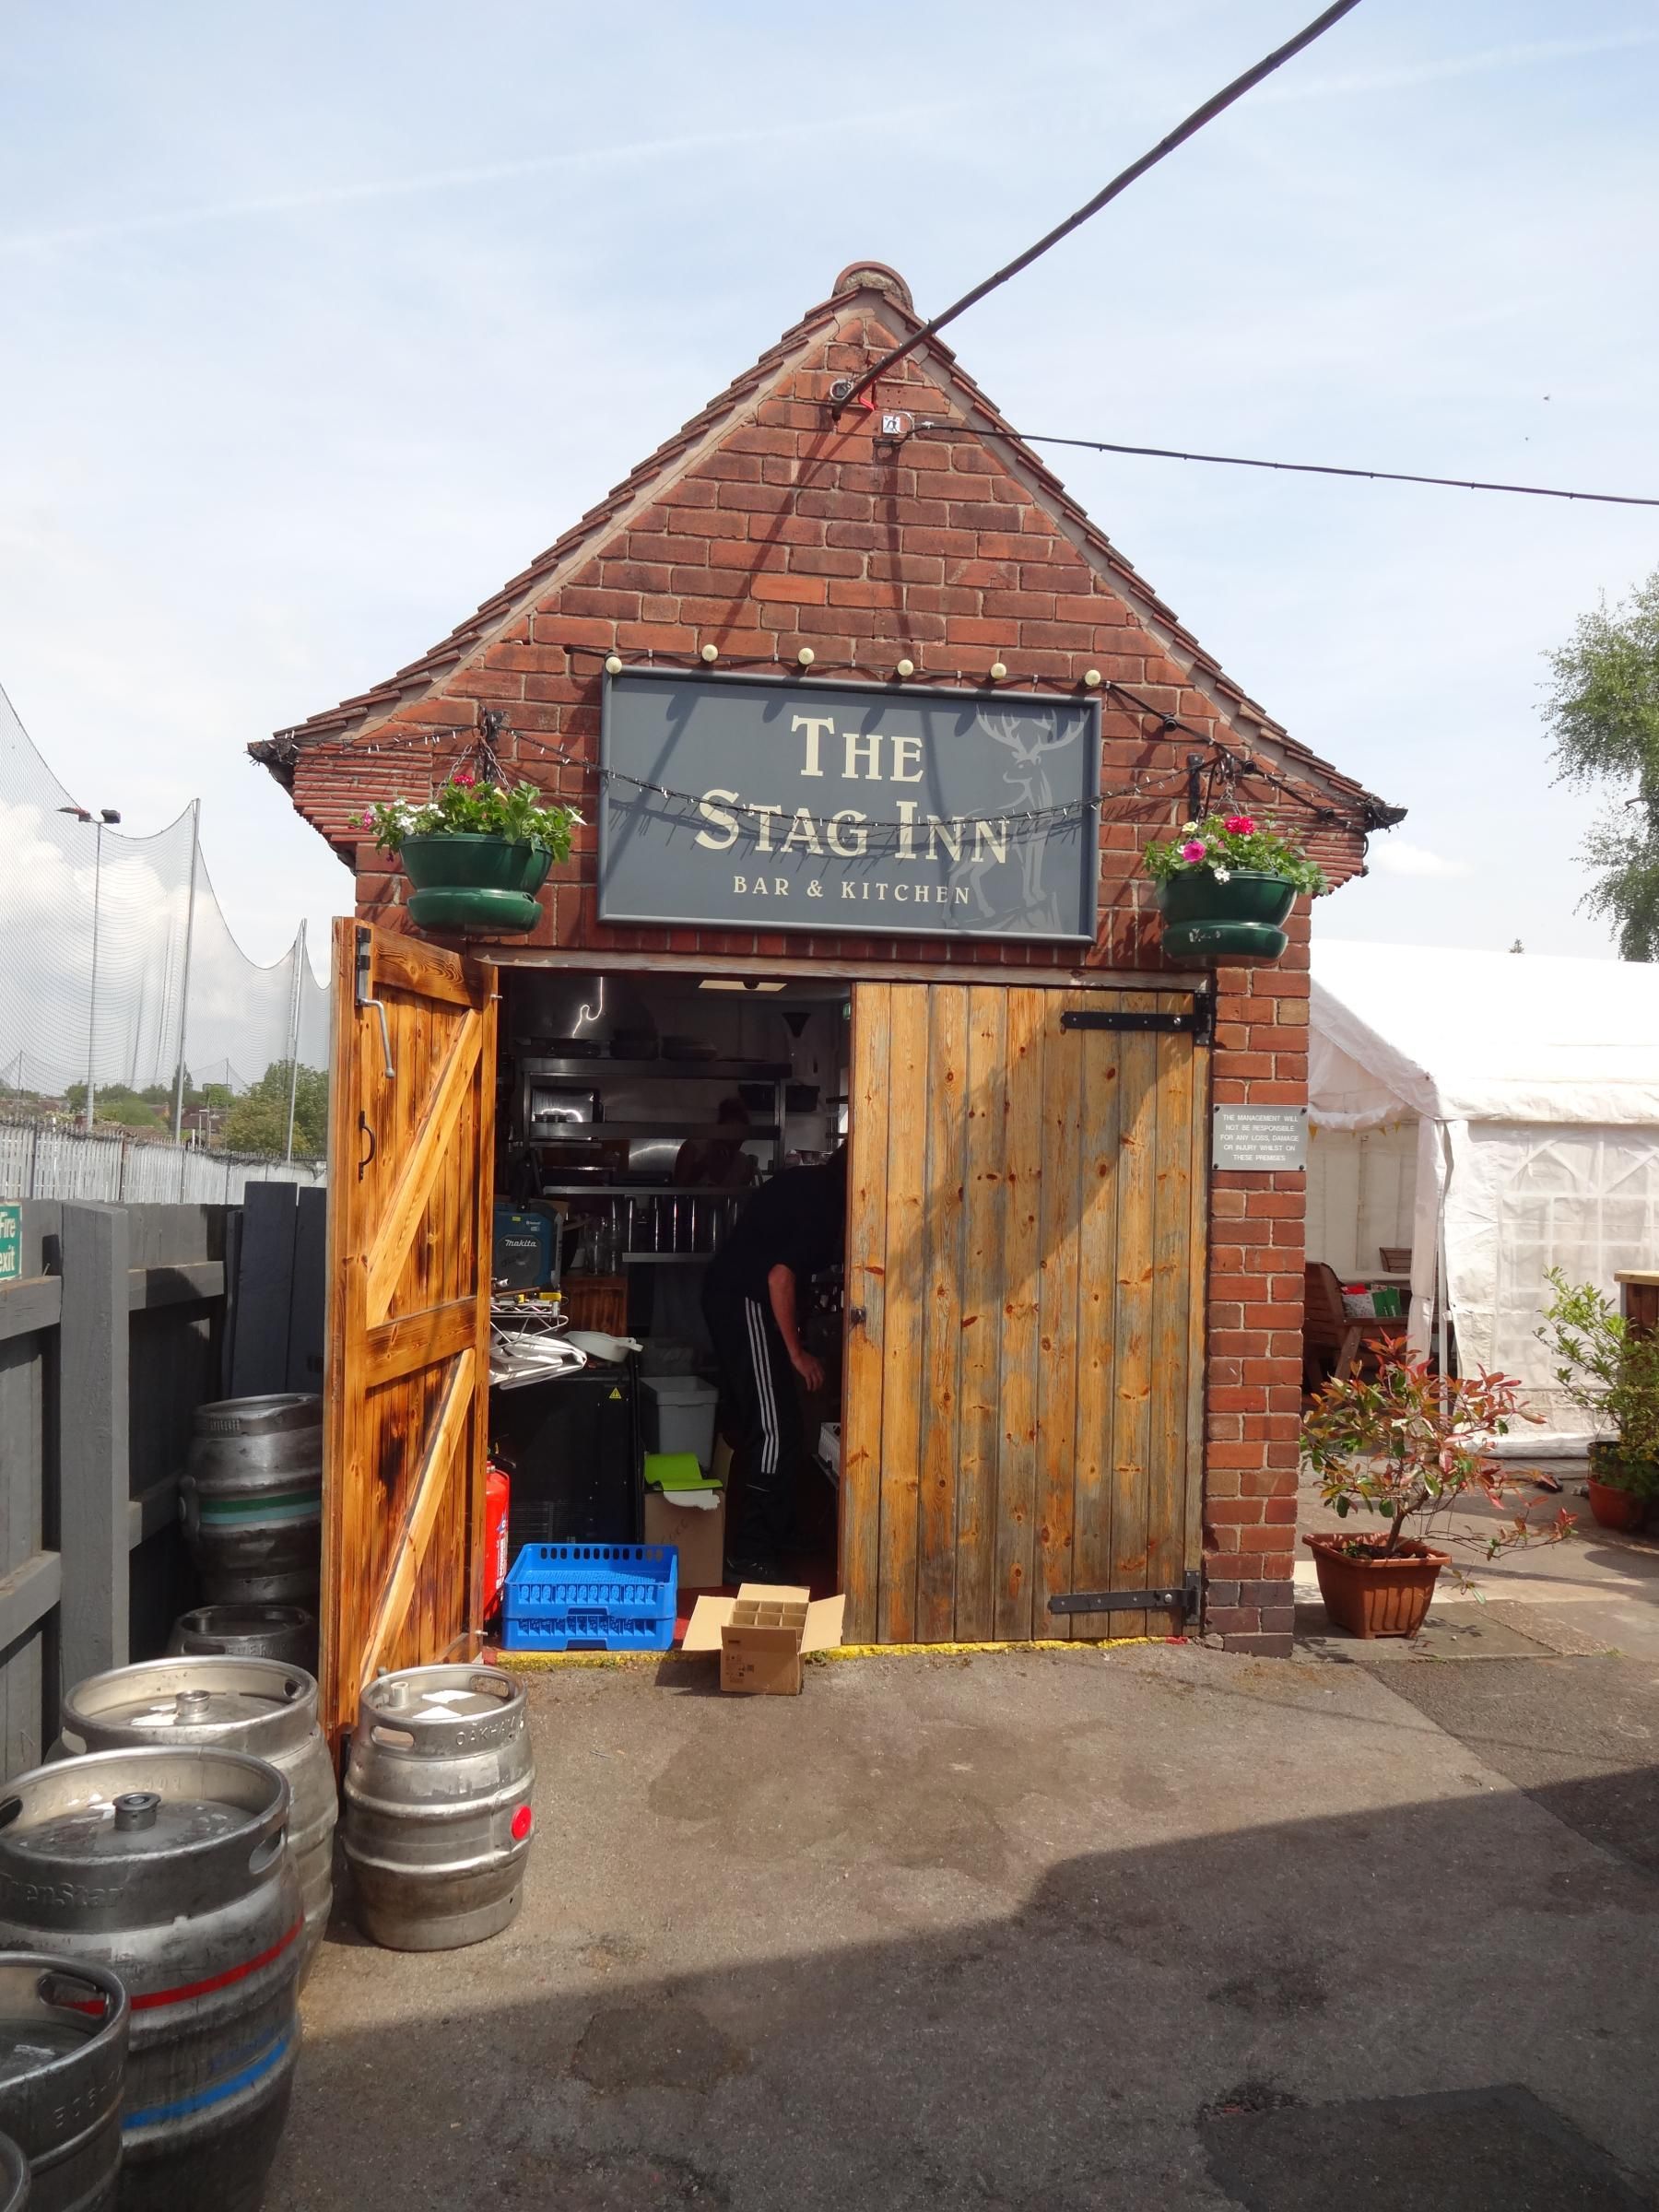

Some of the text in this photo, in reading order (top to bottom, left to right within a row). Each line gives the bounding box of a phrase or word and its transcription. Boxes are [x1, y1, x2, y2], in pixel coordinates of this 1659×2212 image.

[791, 714, 924, 782] THE
[694, 789, 1010, 864] STAG INN
[733, 876, 971, 905] BAR & KITCHEN
[1237, 1114, 1280, 1123] MANAGEMENT
